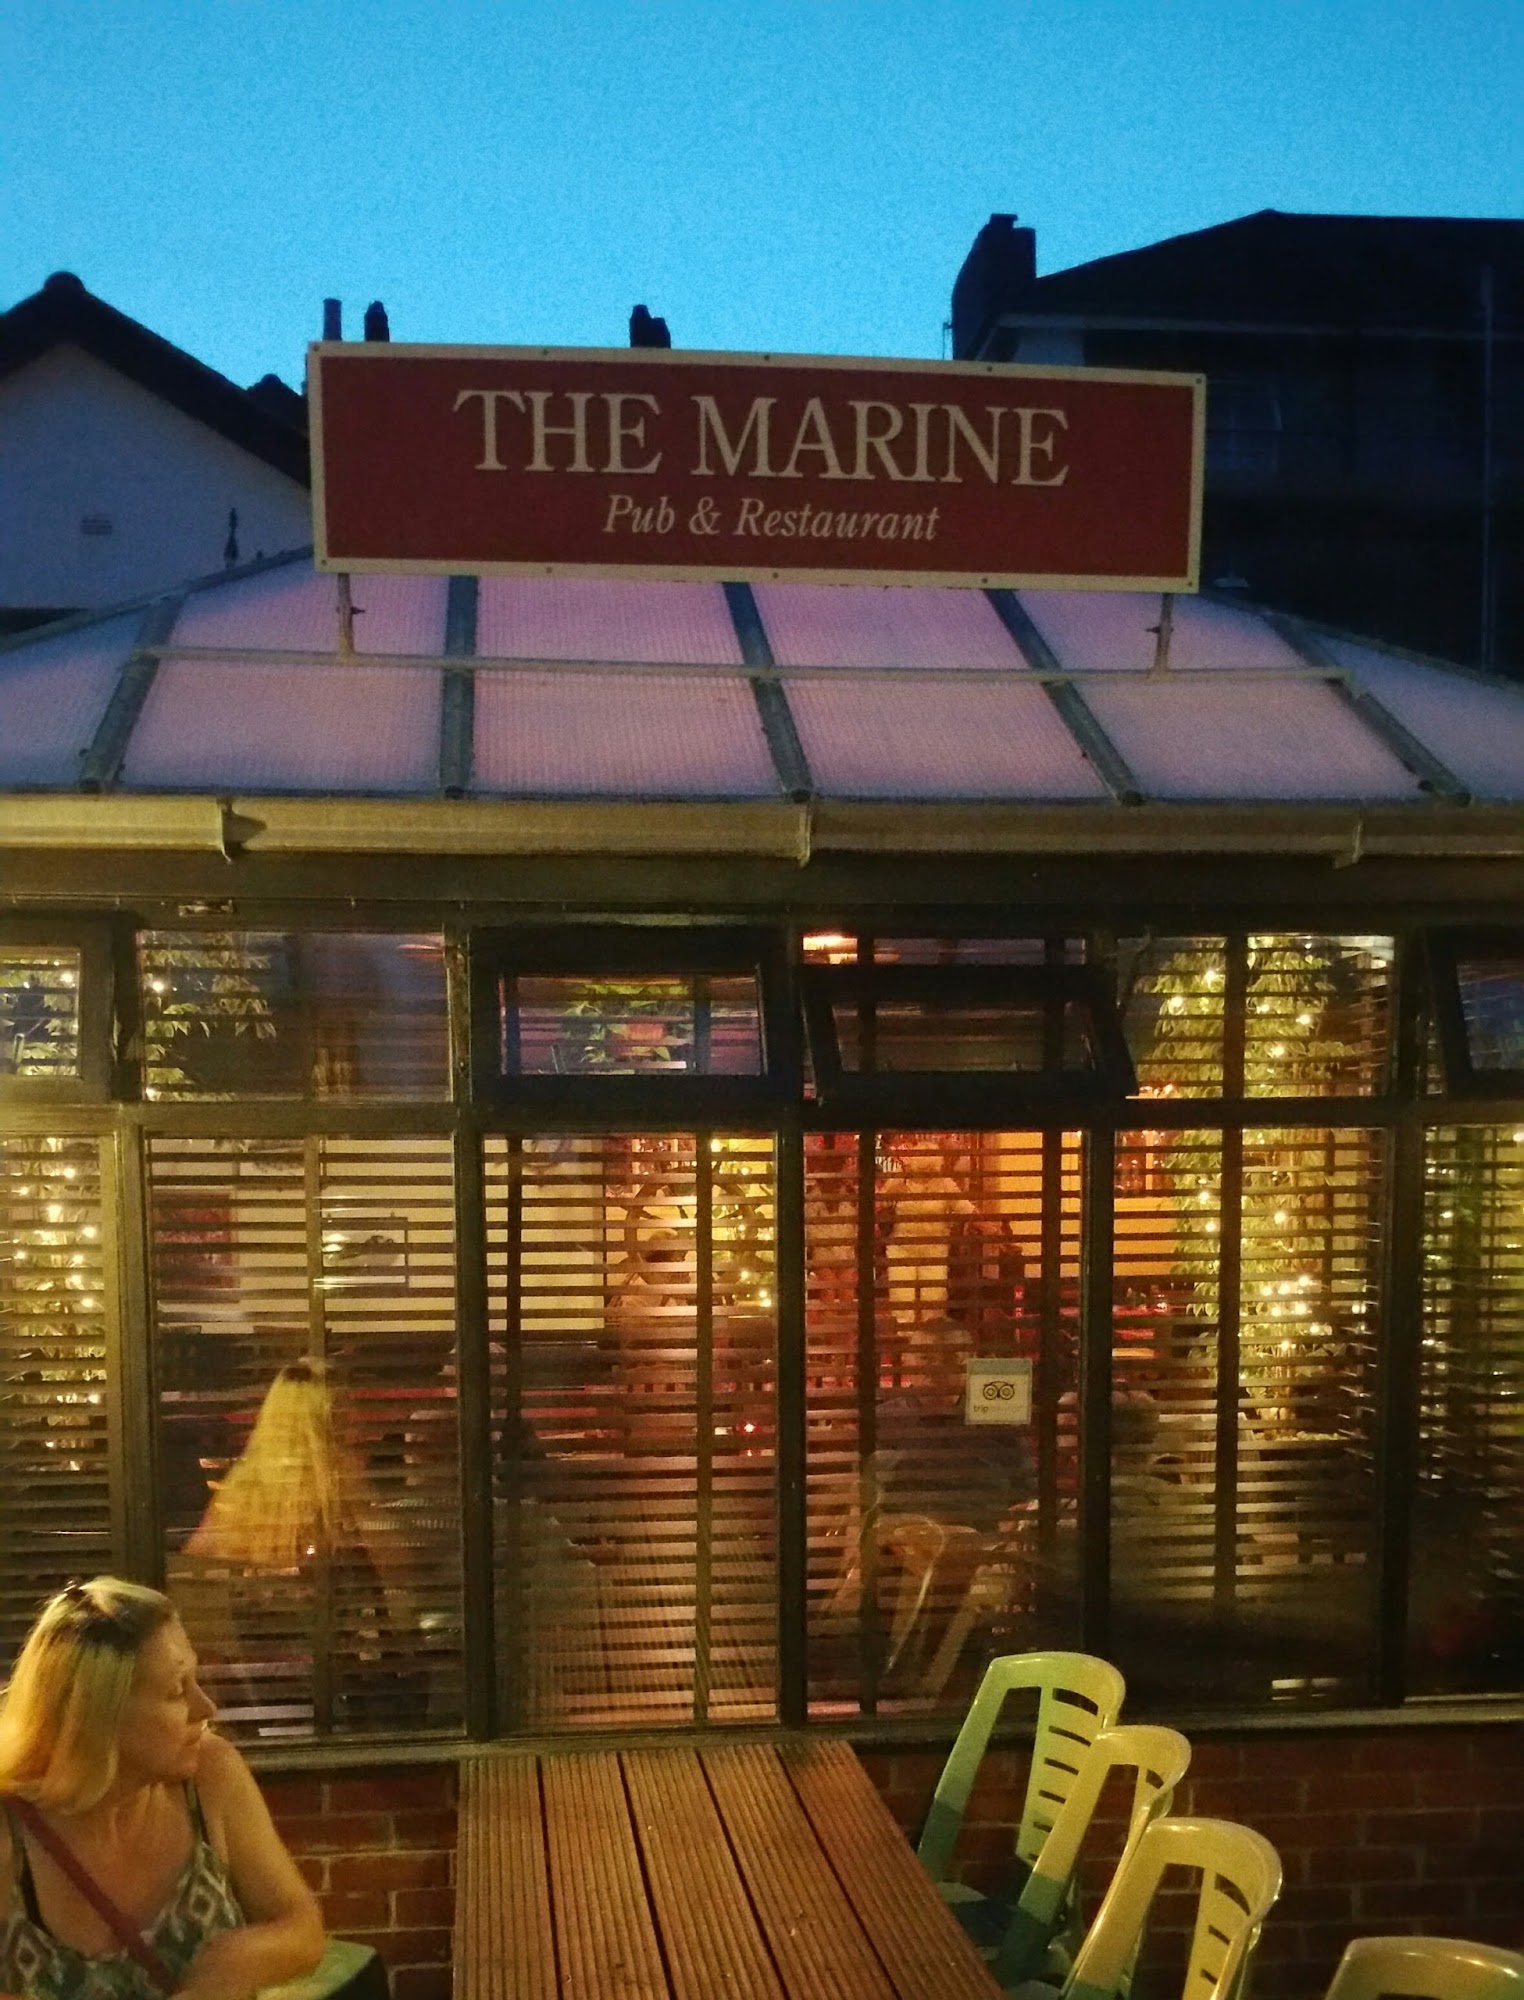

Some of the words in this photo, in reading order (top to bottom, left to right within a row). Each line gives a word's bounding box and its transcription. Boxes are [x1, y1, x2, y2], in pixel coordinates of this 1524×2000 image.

[454, 390, 663, 474] THE
[691, 396, 1068, 487] MARINE
[603, 493, 675, 536] Pub
[688, 497, 719, 536] &
[734, 498, 942, 543] Restaurant
